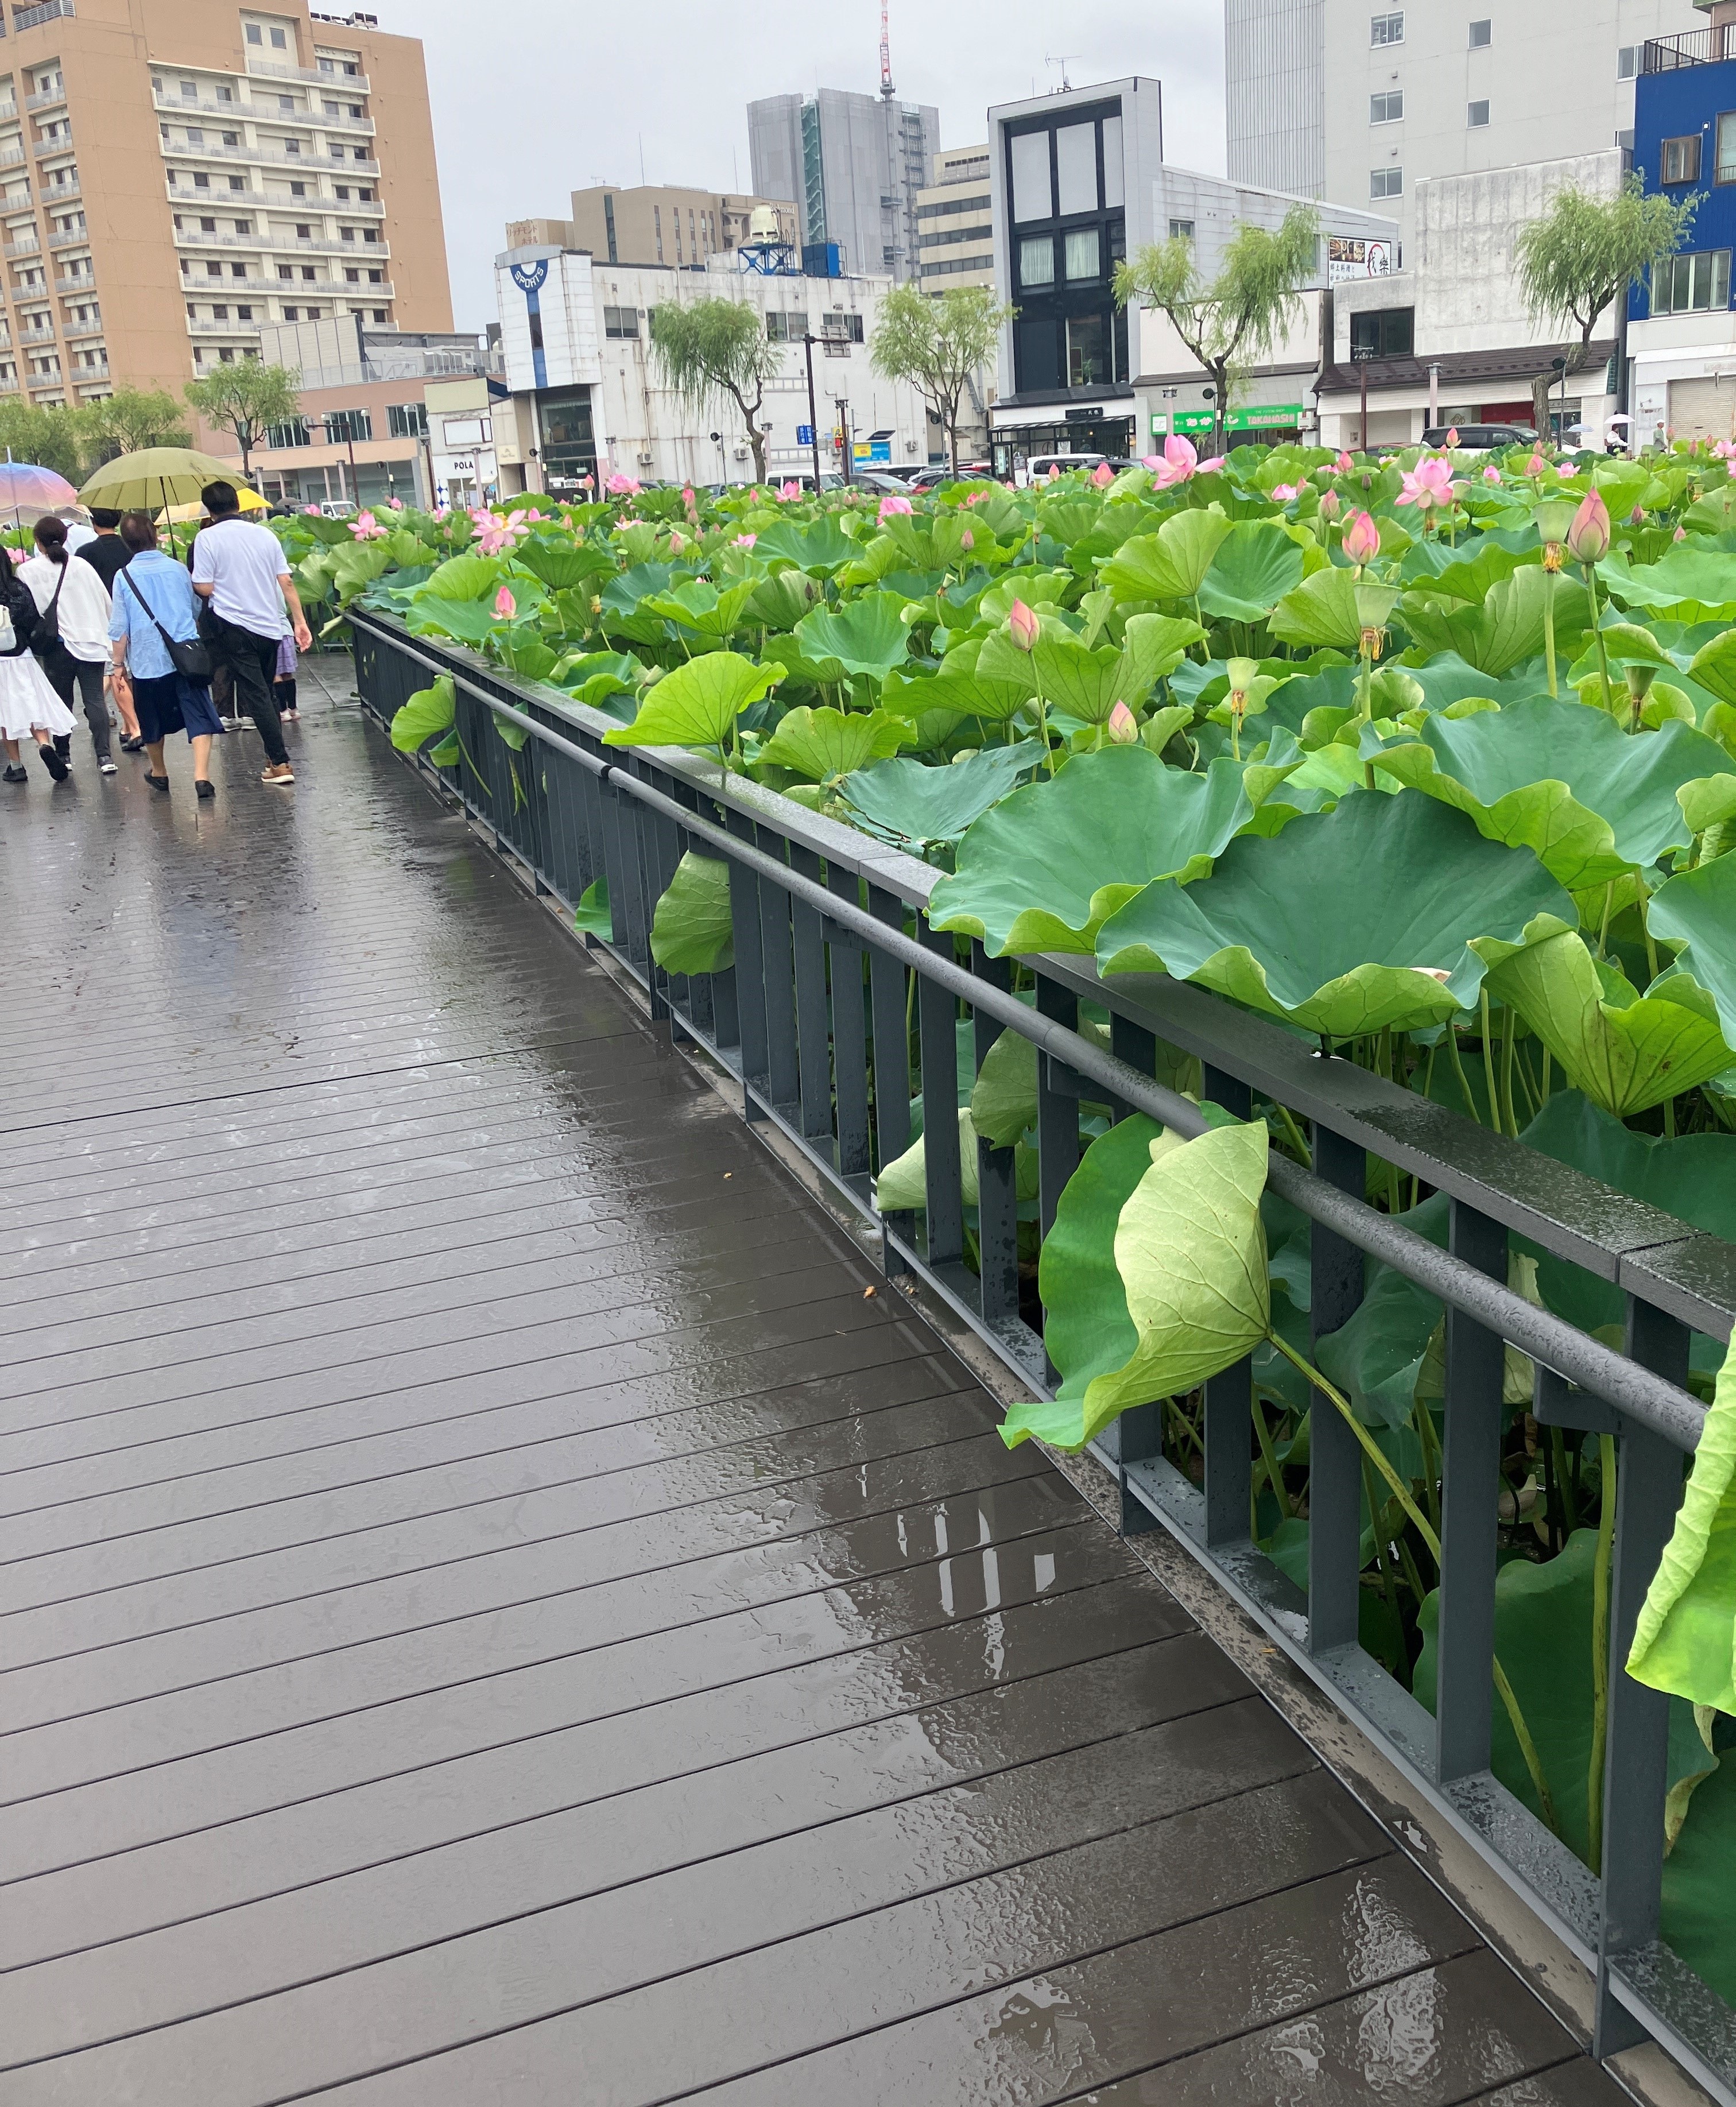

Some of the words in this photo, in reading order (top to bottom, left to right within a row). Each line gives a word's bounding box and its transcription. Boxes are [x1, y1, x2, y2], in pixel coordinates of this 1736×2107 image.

[522, 236, 538, 245] ホテル
[514, 266, 544, 288] SPORTS
[1186, 416, 1239, 427] たかし
[1246, 413, 1295, 425] TAKAHASHI
[454, 461, 474, 470] POLA
